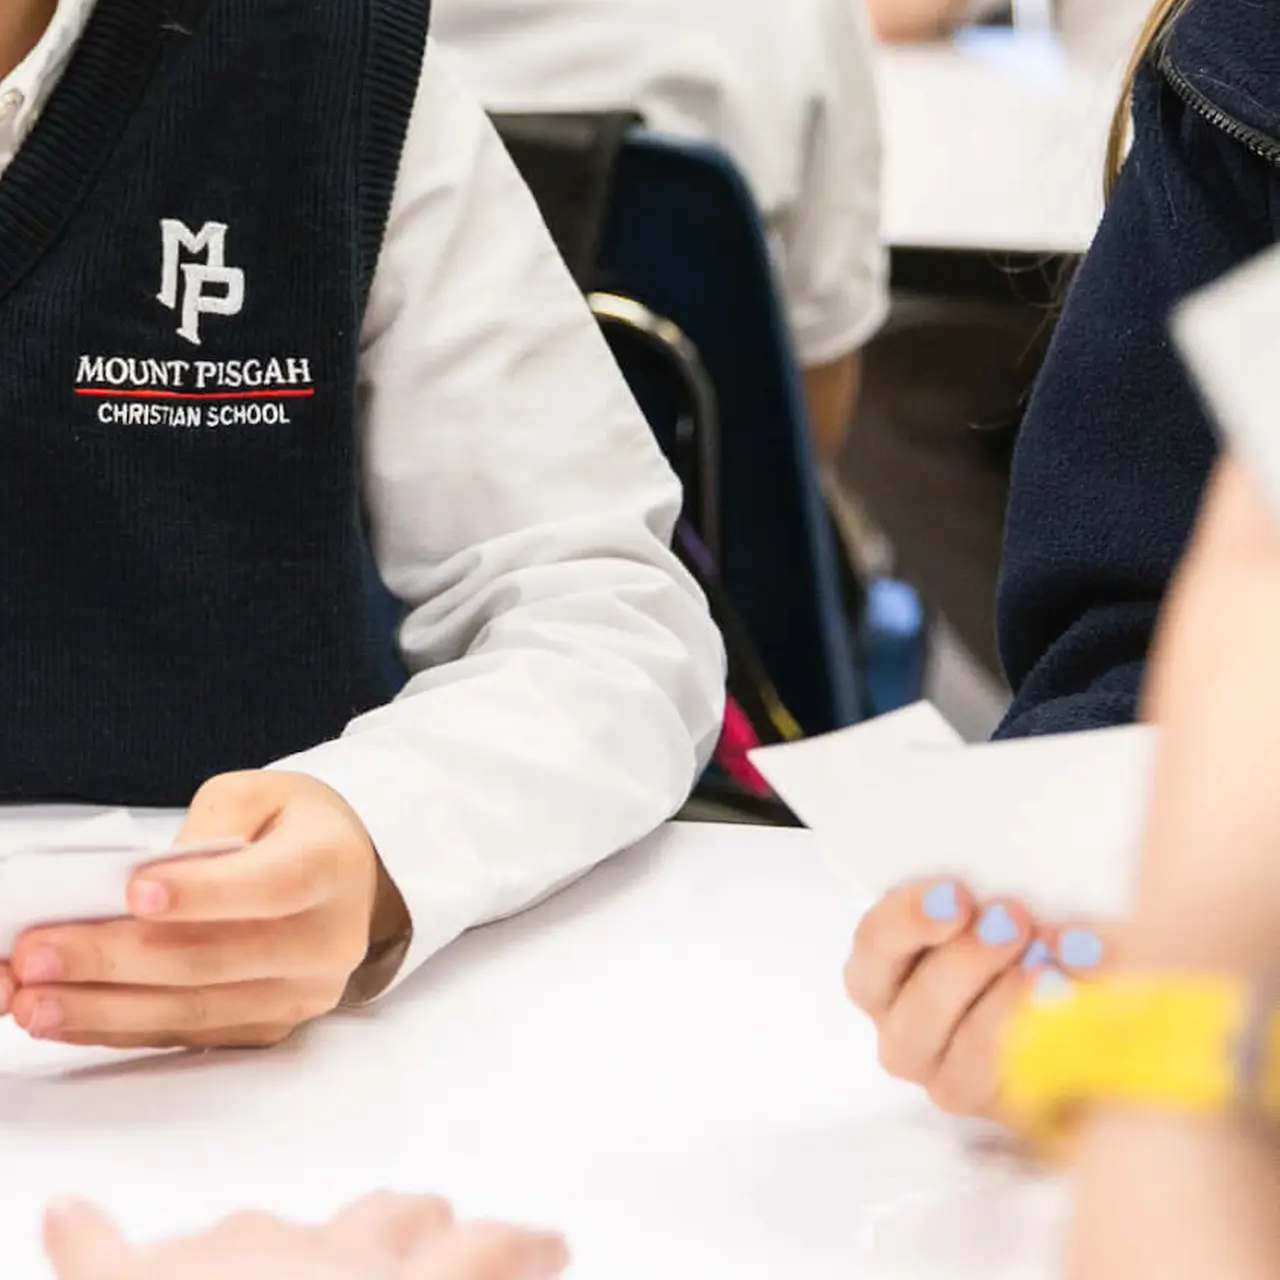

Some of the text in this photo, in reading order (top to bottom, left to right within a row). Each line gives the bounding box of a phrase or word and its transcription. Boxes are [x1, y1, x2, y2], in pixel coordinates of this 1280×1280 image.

[156, 218, 245, 346] MP
[76, 355, 314, 388] MOUNT PISGAH
[97, 402, 290, 427] CHRISTIAN SCHOOL
